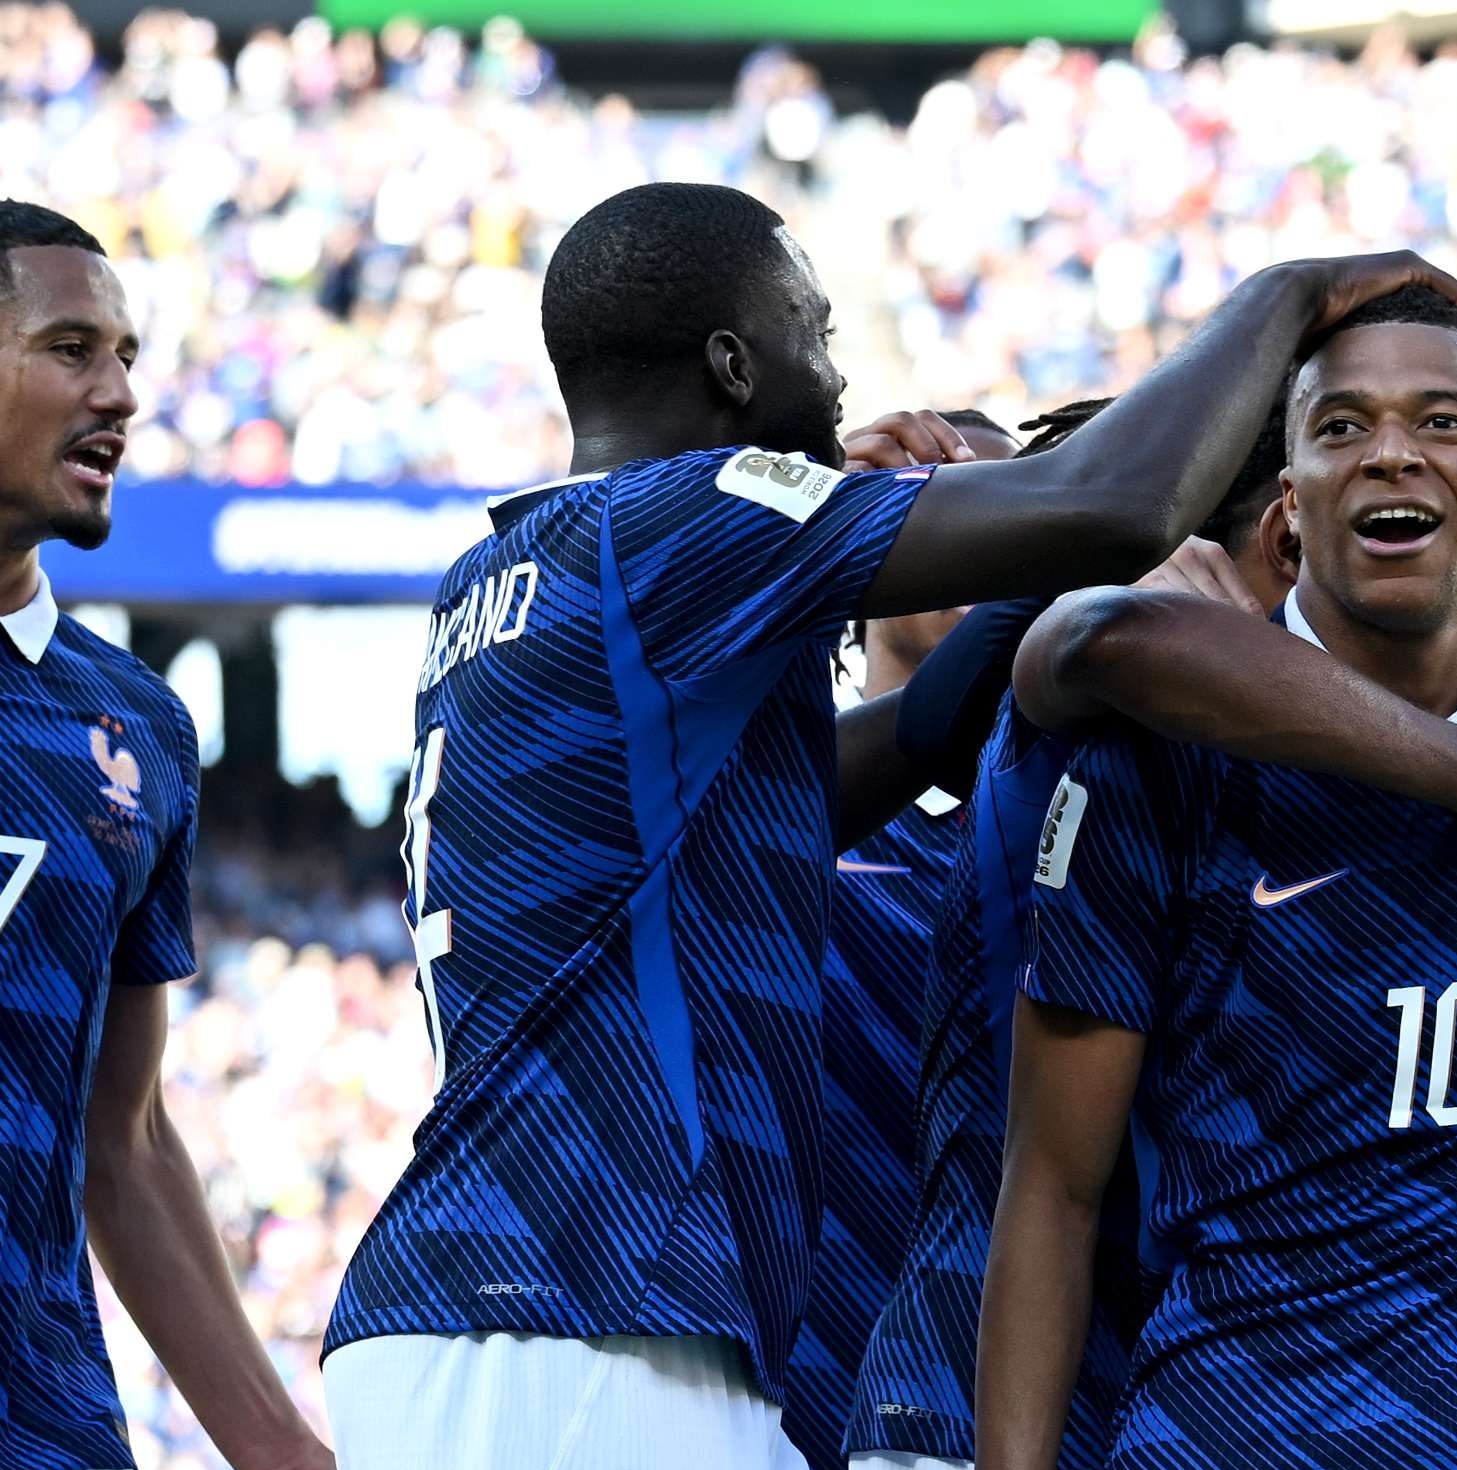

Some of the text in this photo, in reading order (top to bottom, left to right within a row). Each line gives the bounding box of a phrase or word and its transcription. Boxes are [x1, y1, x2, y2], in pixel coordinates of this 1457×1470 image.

[808, 473, 832, 500] 2026
[476, 1283, 565, 1298] AERO-FIT
[877, 1403, 937, 1420] ERO-FIT
